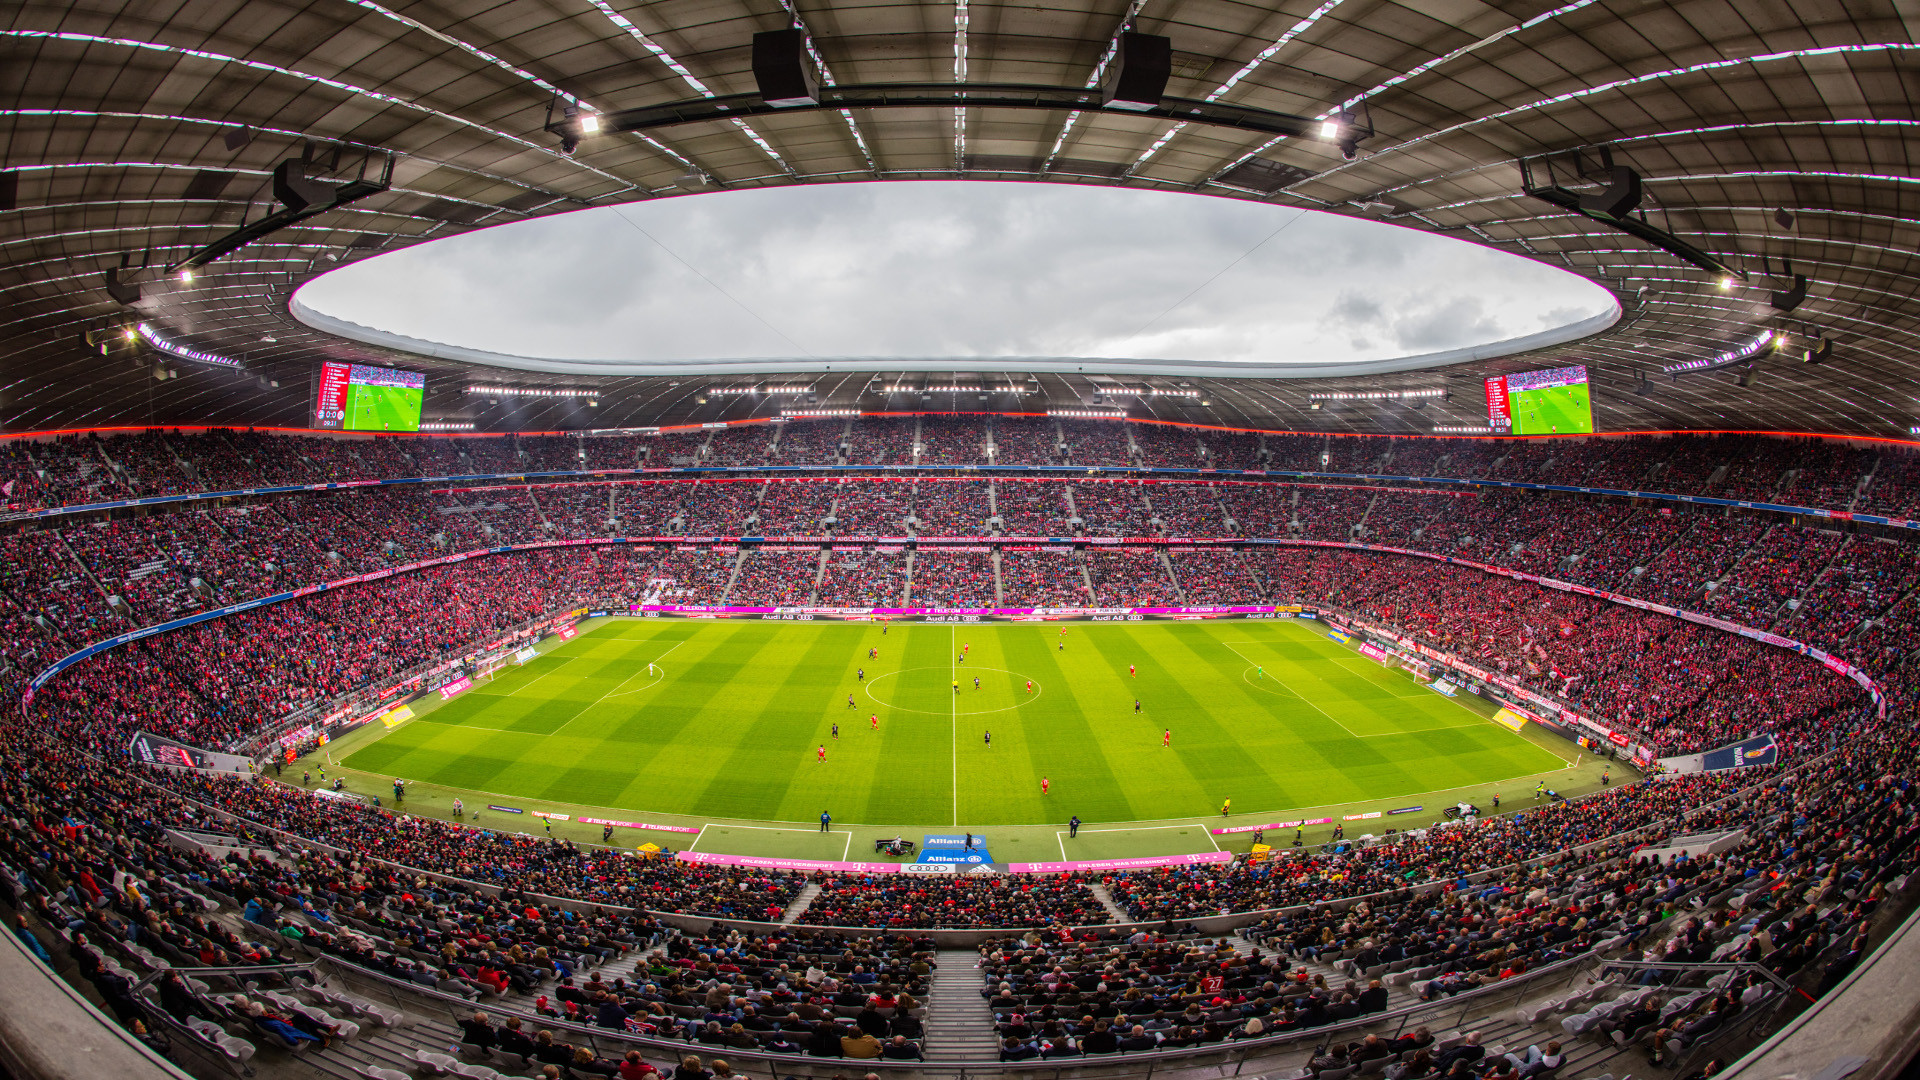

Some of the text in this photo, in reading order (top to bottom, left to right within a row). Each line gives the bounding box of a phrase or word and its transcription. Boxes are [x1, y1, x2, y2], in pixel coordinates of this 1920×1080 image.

[427, 683, 441, 694] Audi
[442, 676, 451, 686] A8
[1442, 672, 1465, 688] Audi A8
[1209, 979, 1221, 989] 27
